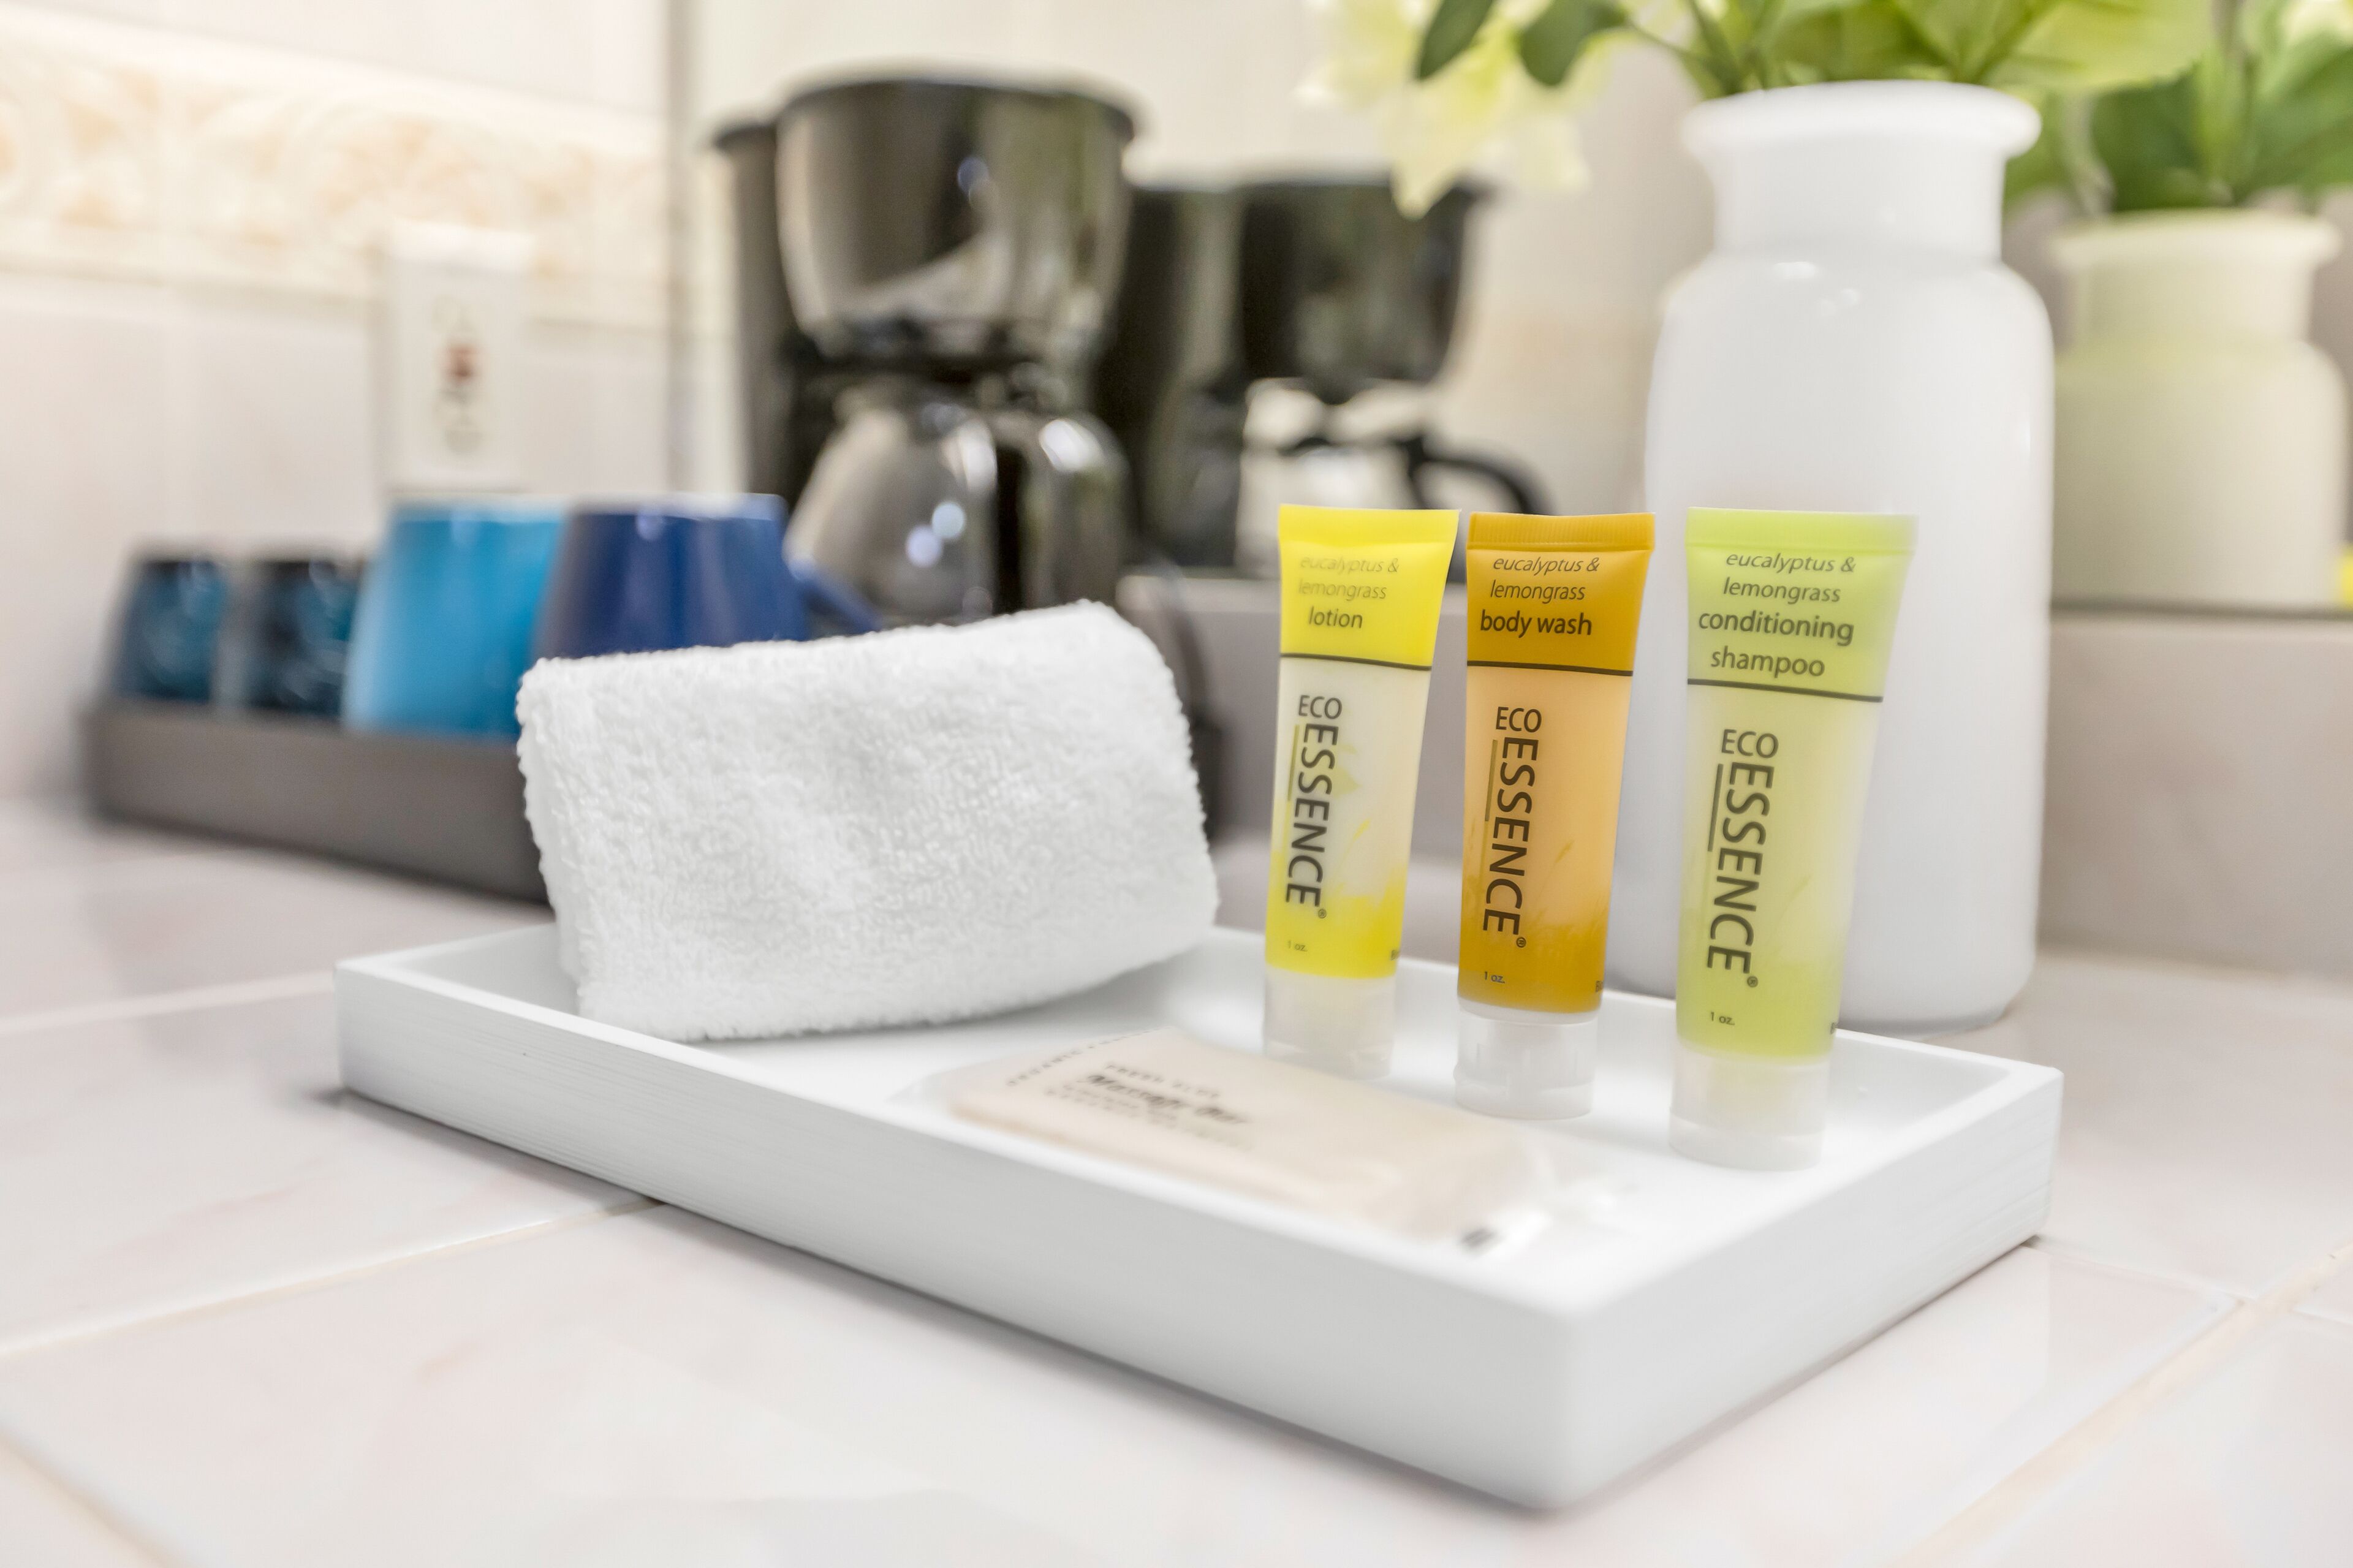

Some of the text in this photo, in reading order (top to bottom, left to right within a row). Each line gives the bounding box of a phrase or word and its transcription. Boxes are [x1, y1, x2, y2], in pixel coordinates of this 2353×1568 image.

[1300, 555, 1400, 575] eucalyptus &
[1492, 556, 1600, 577] eucalyptus &
[1726, 552, 1856, 574] eucalyptus &
[1298, 578, 1387, 601] lemongrass
[1490, 580, 1586, 603] lemongrass
[1722, 577, 1841, 605] lemongrass
[1308, 606, 1363, 629] lotion
[1480, 610, 1593, 638] body wash
[1699, 610, 1855, 646] conditioning
[1710, 645, 1825, 678] shampoo
[1298, 694, 1343, 719] ECO
[1495, 706, 1542, 733] ECO
[1721, 729, 1779, 759] ECO
[1485, 971, 1506, 983] 1 oz.
[1711, 1012, 1735, 1026] 1 oz.
